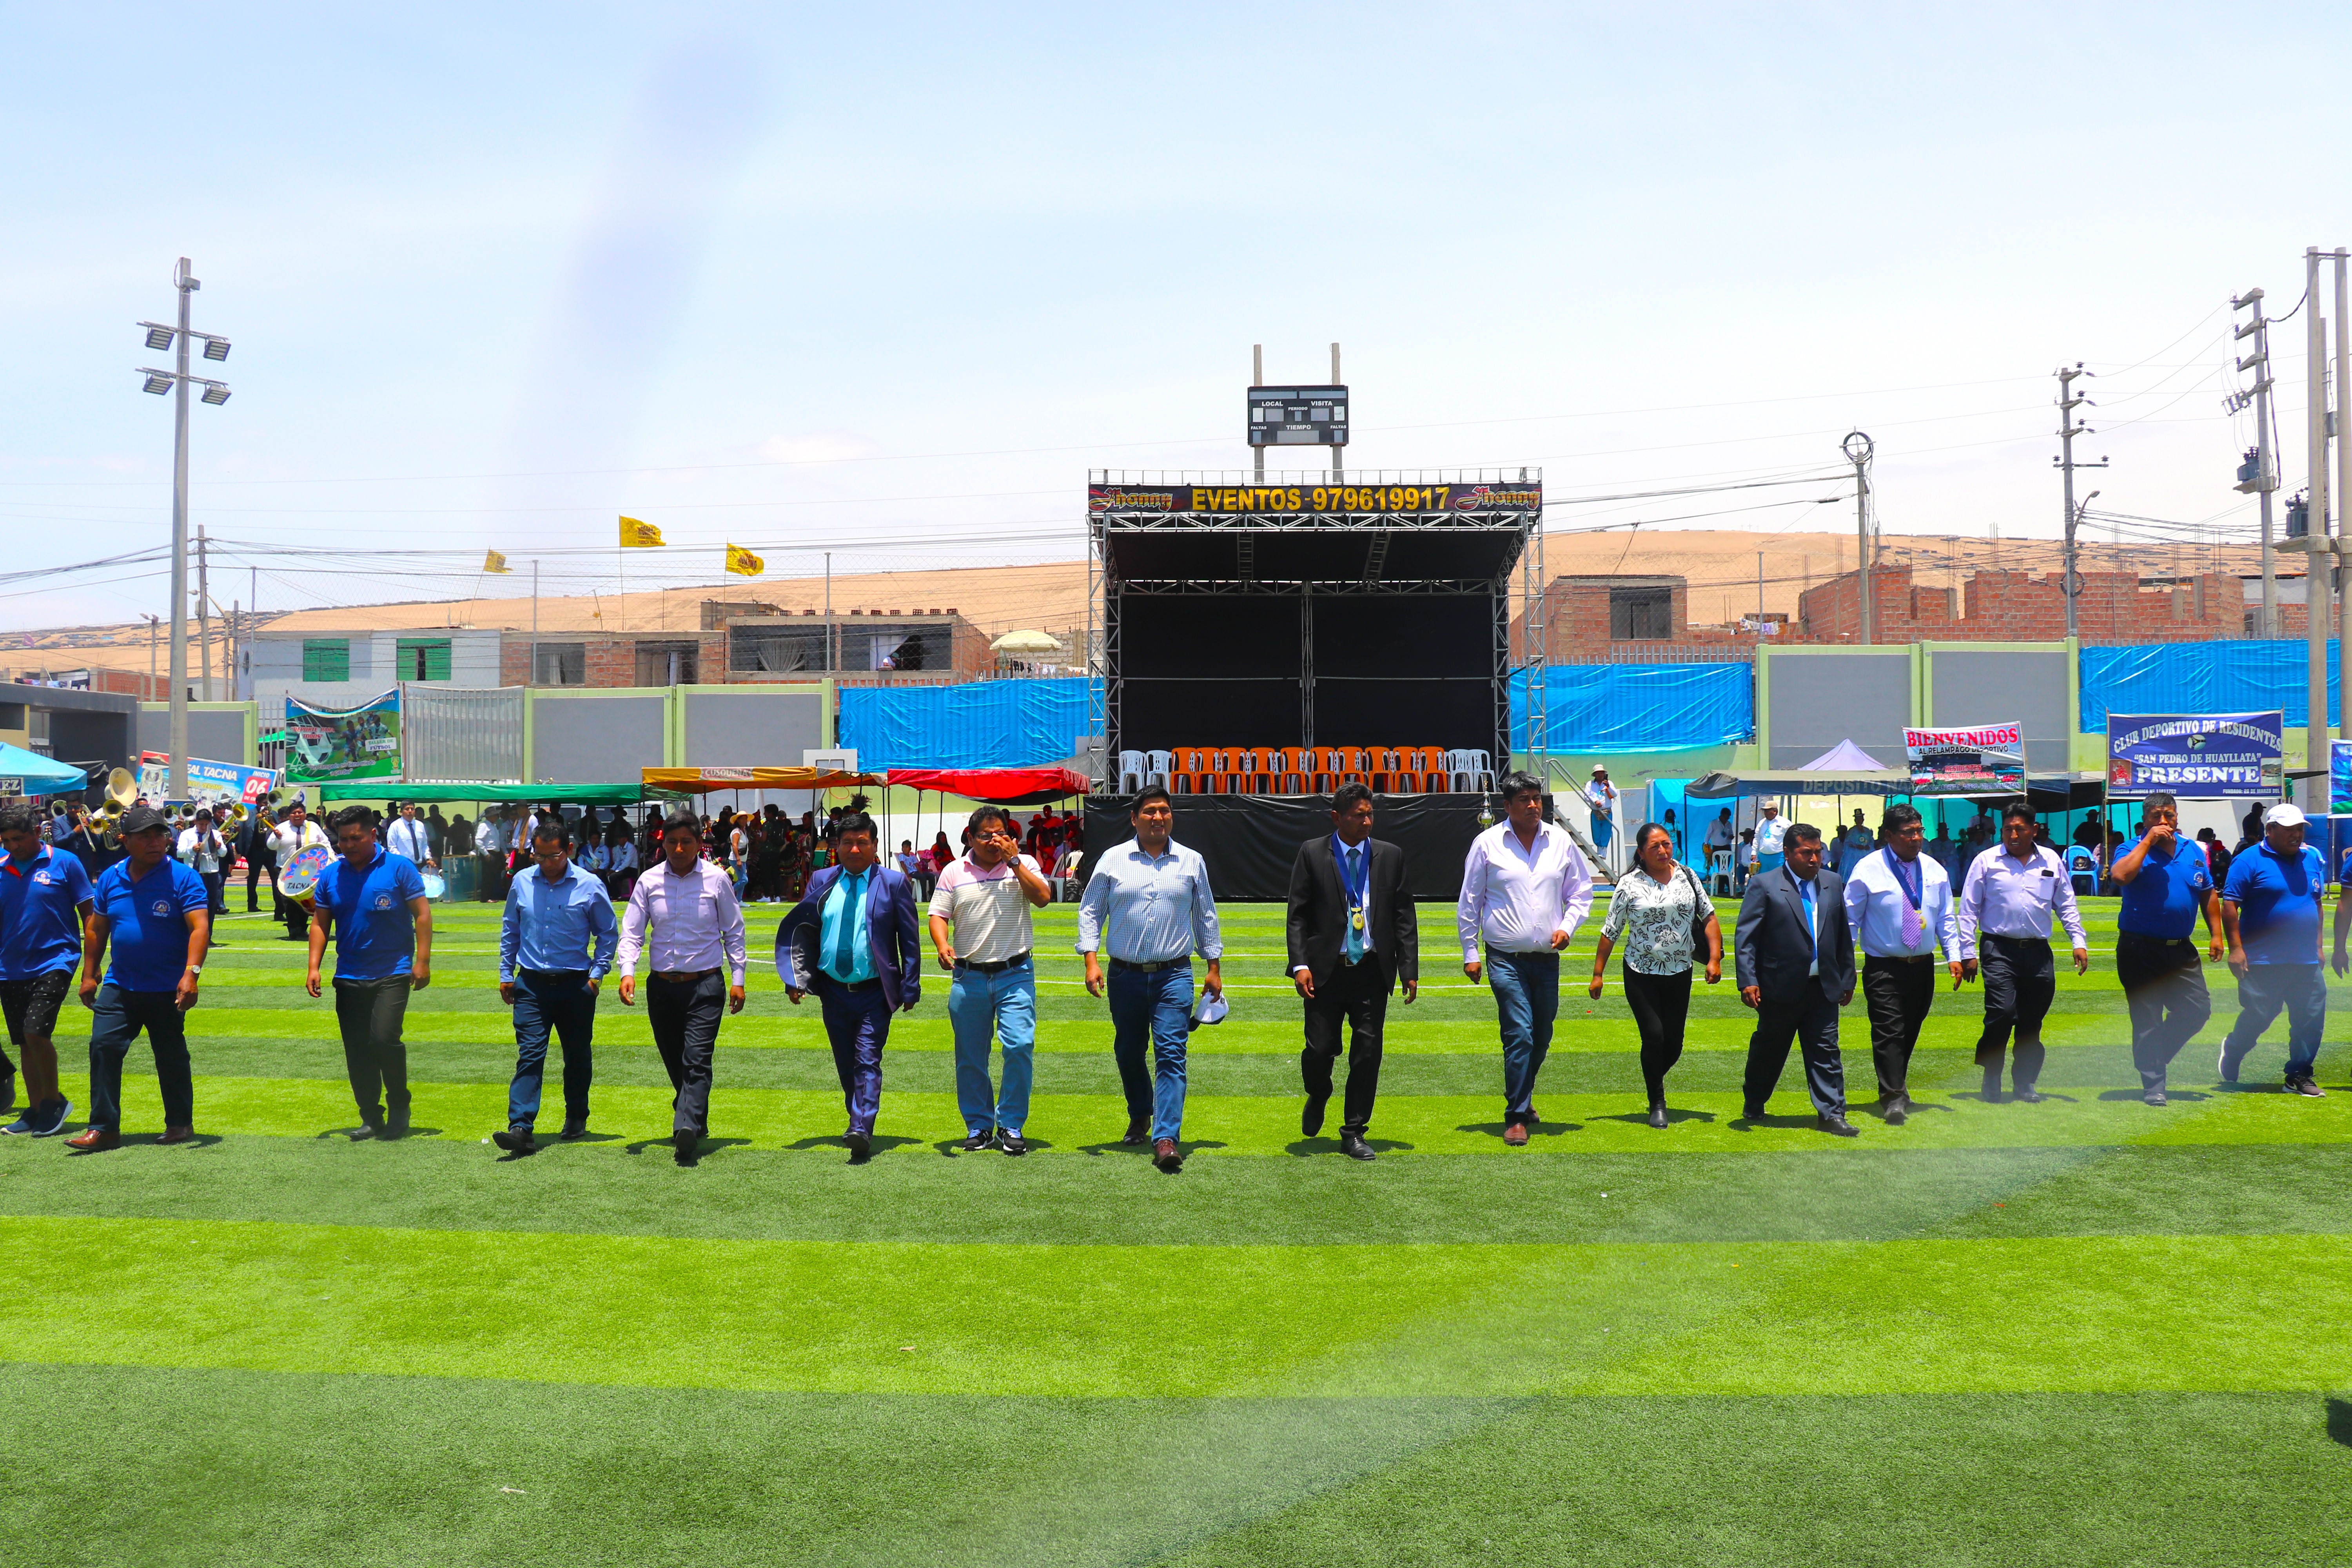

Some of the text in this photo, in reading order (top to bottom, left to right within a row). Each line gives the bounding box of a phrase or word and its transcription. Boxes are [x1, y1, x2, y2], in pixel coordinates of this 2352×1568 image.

[1089, 487, 1173, 512] Jhonny
[1455, 486, 1541, 511] Jhonny
[1906, 728, 2018, 747] BIENVENIDOS
[2114, 720, 2281, 753] CLUB DEPORTIVO DE RESIDENTES
[1929, 745, 1970, 754] RELAMPAGO
[1972, 745, 2009, 753] DEPORTIVO
[2159, 754, 2188, 764] PEDRO
[2190, 754, 2202, 763] DE
[204, 766, 237, 781] TACNA
[1945, 764, 1982, 773] RESIDENTES
[2137, 766, 2260, 784] PRESENTE
[246, 779, 267, 795] 06
